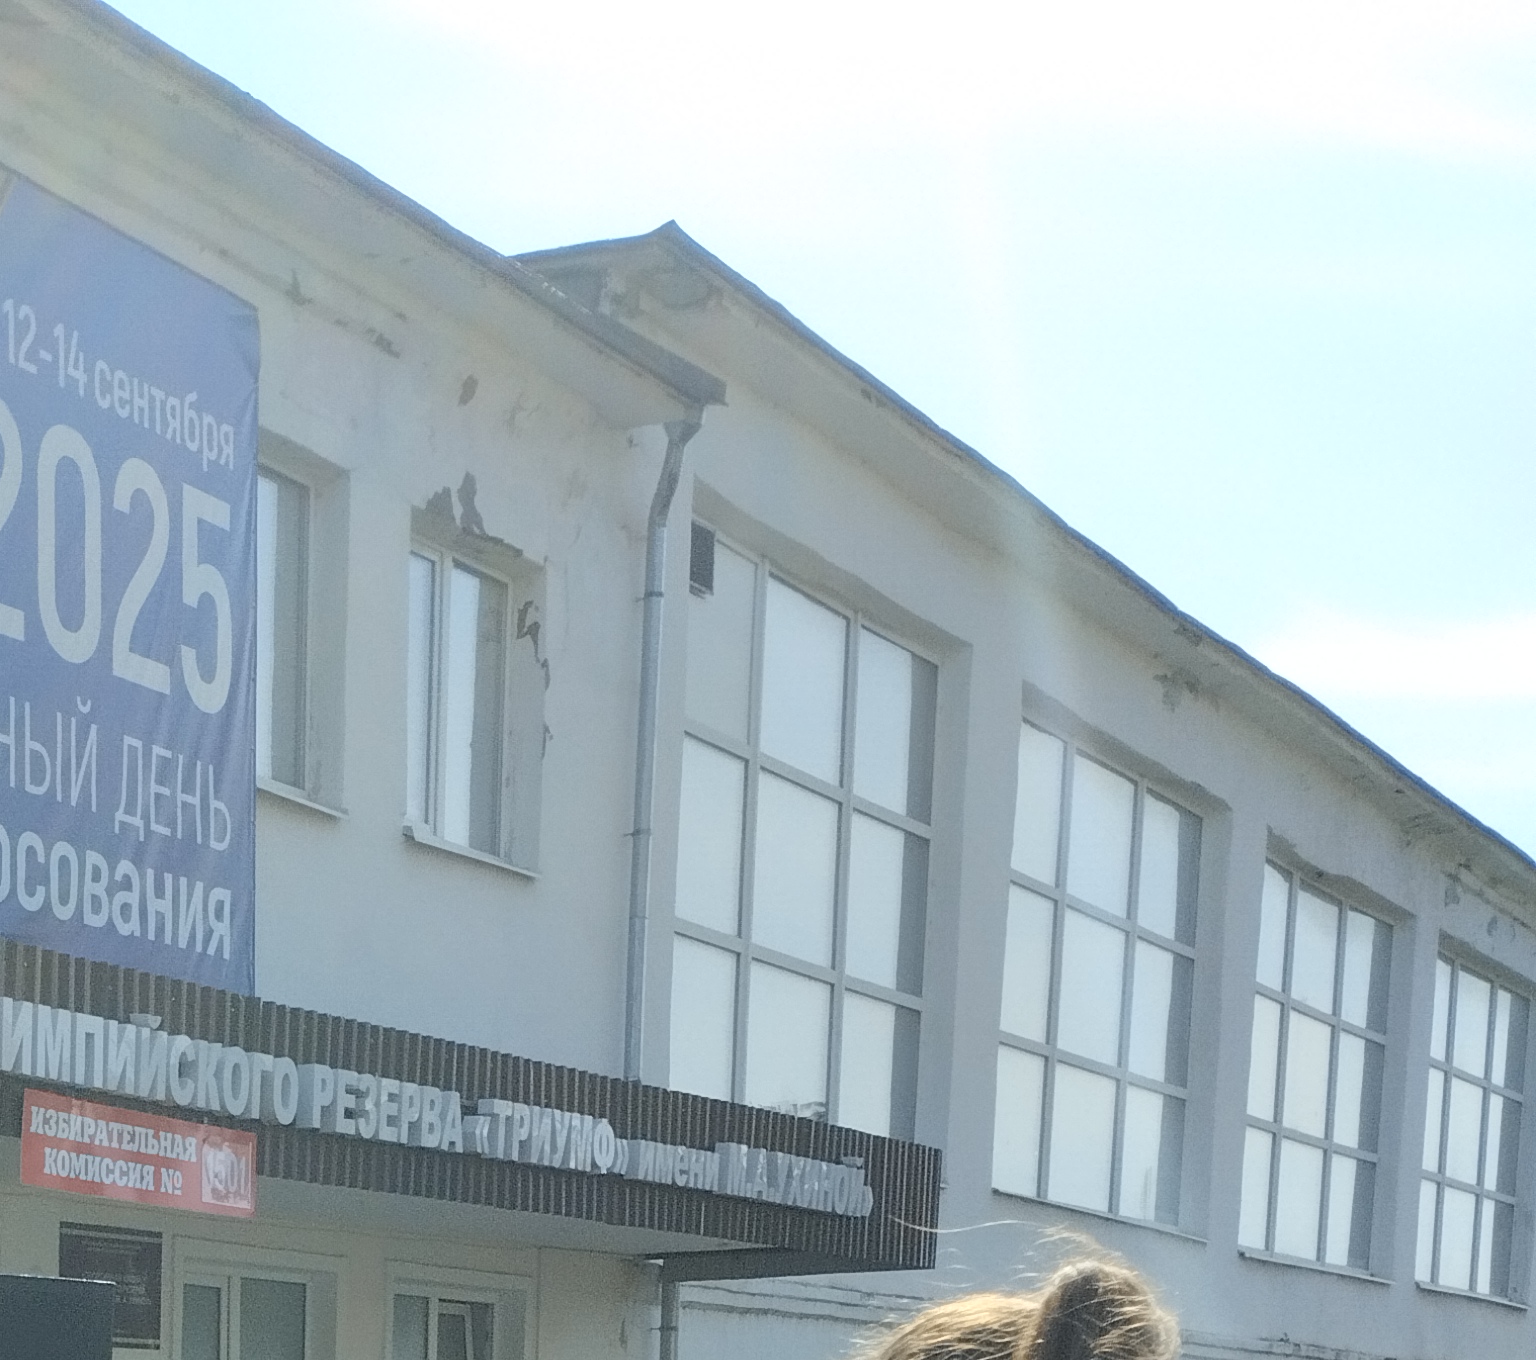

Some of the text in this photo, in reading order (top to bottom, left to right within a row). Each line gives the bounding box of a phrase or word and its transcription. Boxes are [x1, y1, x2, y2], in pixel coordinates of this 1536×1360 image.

[2, 297, 235, 471] 12-14 сентября
[114, 735, 233, 852] ДЕНЬ
[30, 1106, 198, 1163] ИЗБИРАТЕЛЬНАЯ
[296, 1062, 462, 1153] РЕЗЕРВА
[43, 1146, 155, 1192] КОМИССИЯ
[160, 1167, 183, 1196] №
